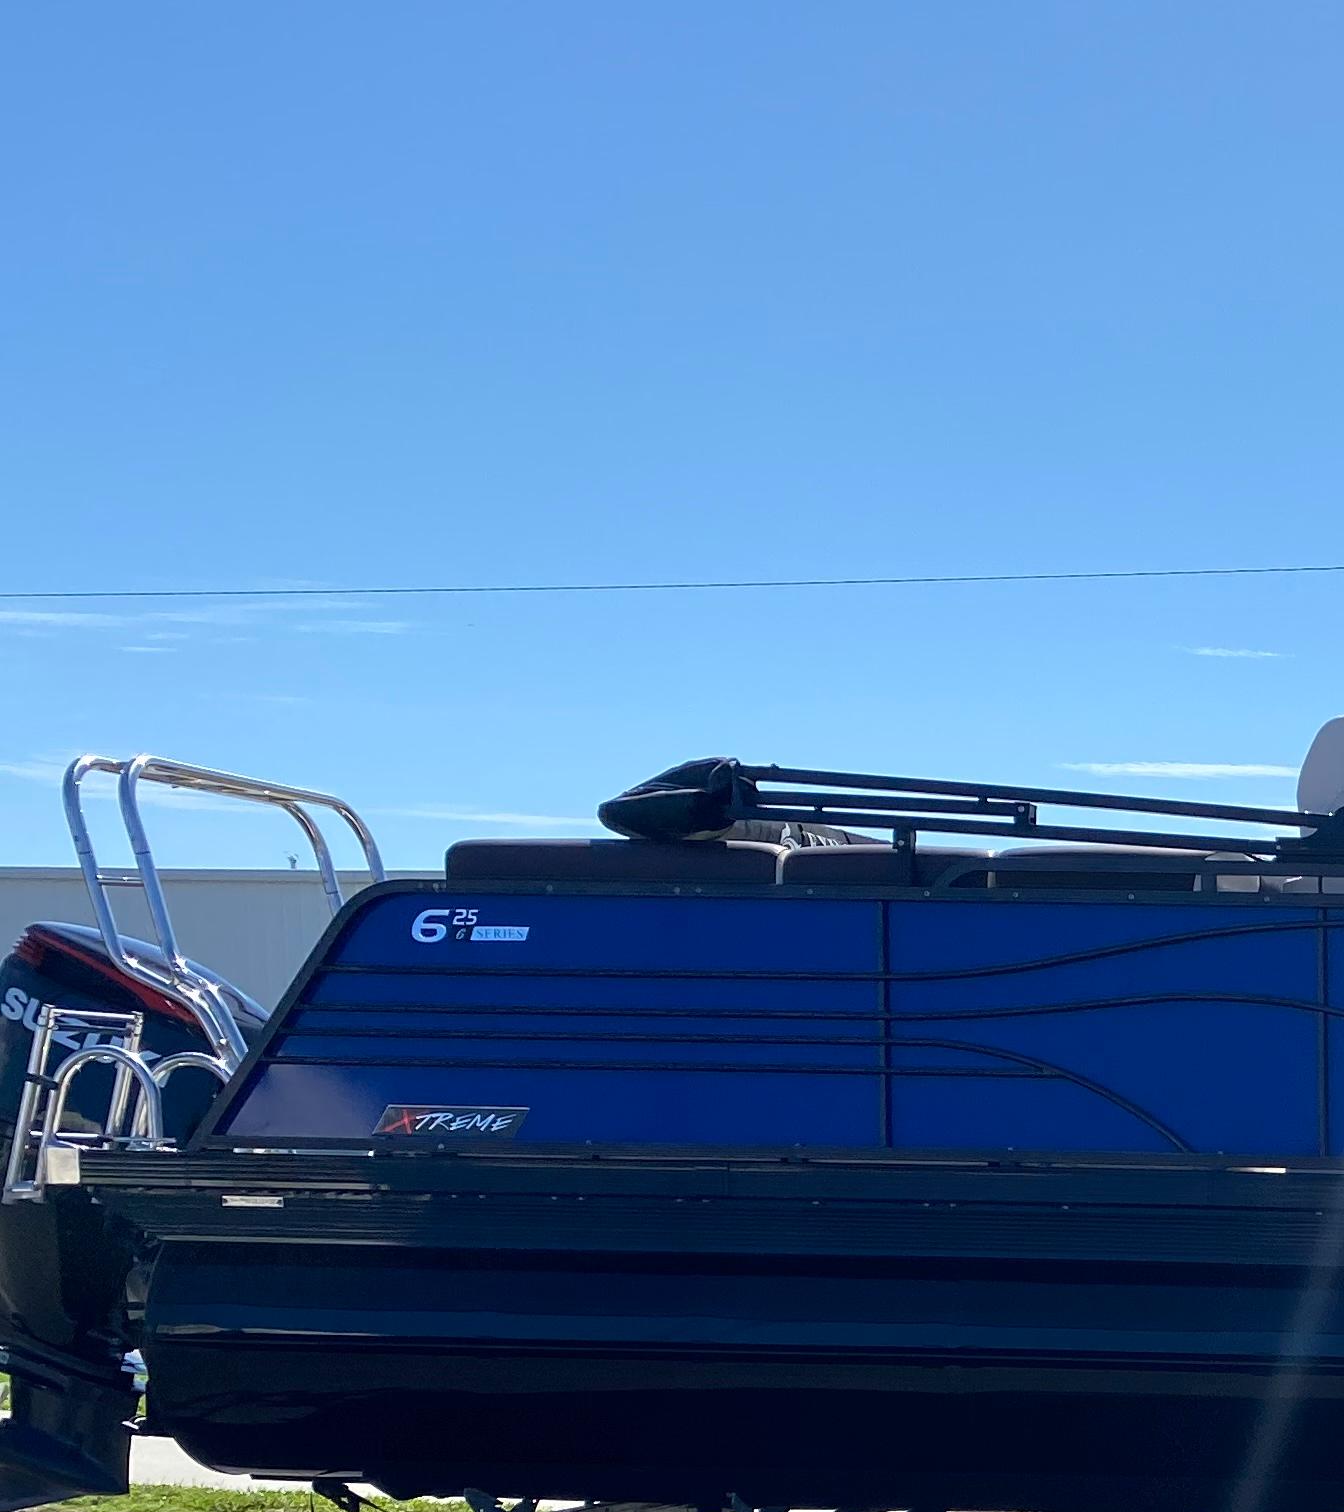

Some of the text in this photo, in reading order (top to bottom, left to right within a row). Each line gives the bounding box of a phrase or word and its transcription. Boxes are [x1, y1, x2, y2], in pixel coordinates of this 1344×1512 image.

[411, 909, 479, 943] 6 25
[476, 927, 524, 939] SERIES
[383, 1108, 517, 1136] XTREME
